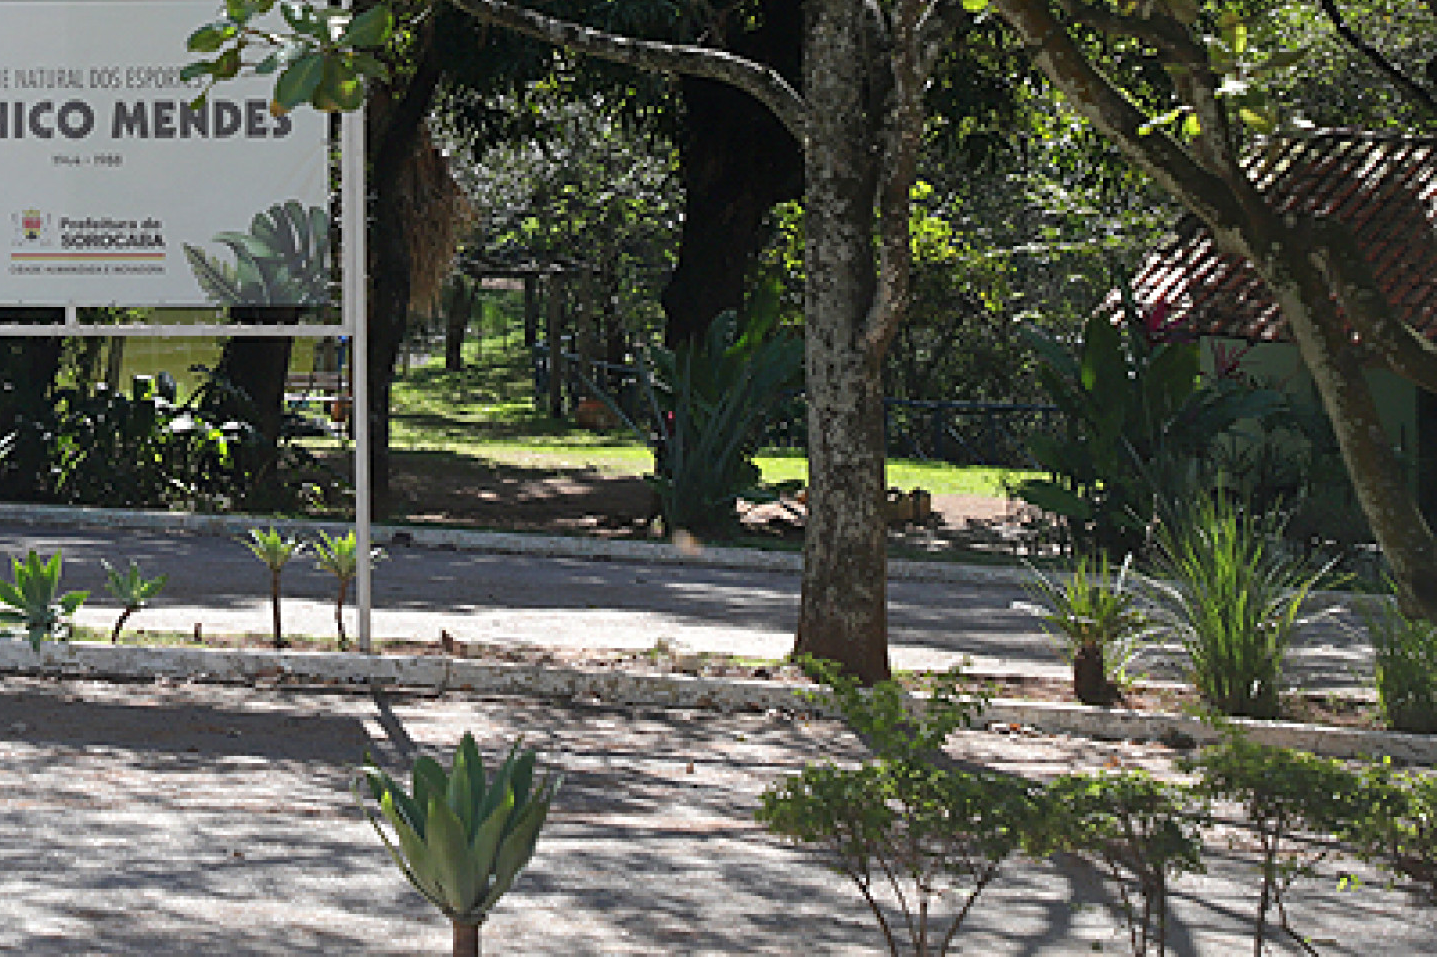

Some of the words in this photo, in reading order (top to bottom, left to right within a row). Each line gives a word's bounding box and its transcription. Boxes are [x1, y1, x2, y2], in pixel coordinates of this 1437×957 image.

[14, 67, 84, 89] NATURAL
[89, 67, 120, 89] DOS
[125, 67, 203, 89] ESPORS
[111, 100, 293, 139] MENDES
[60, 216, 138, 230] Prefeitura
[61, 232, 166, 249] SOROCABA
